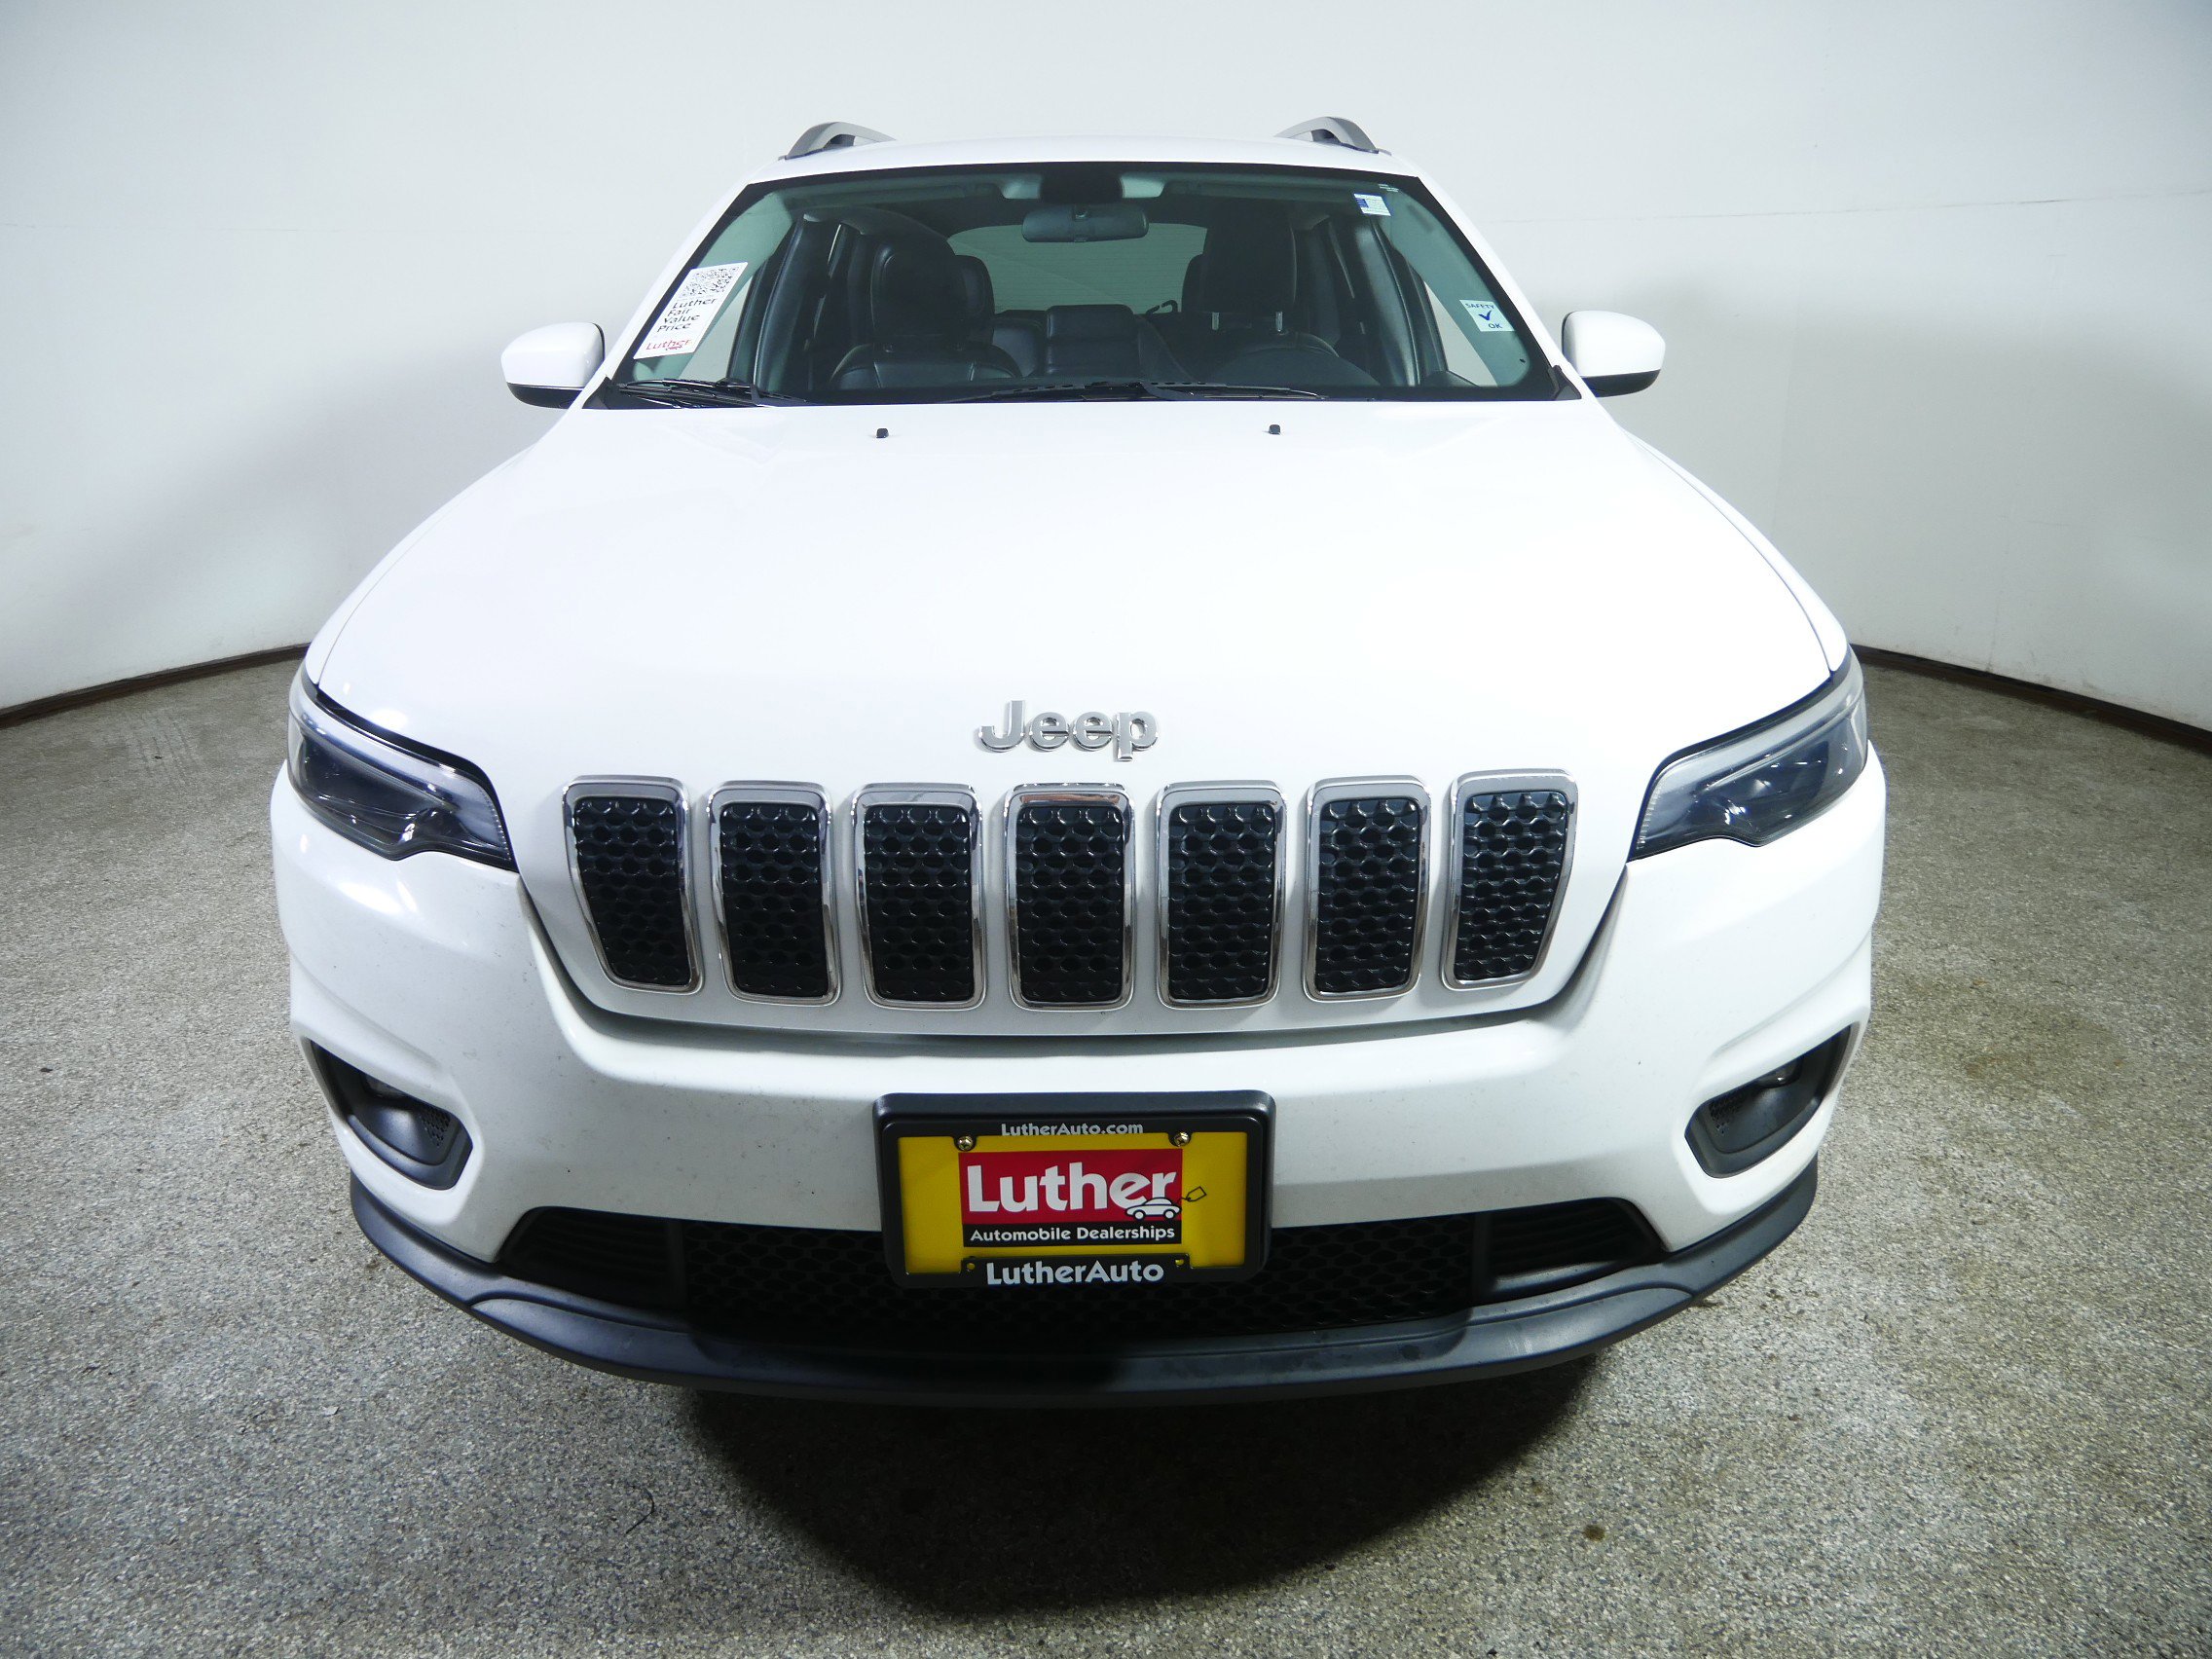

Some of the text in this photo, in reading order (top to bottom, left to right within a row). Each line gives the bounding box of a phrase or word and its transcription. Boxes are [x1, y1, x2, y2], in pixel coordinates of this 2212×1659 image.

[977, 700, 1159, 762] Jeep
[1000, 1123, 1144, 1137] LutherAuto.com
[967, 1161, 1177, 1213] Luther
[970, 1225, 1175, 1241] Automobile Dealerships
[986, 1260, 1164, 1286] LutherAuto
